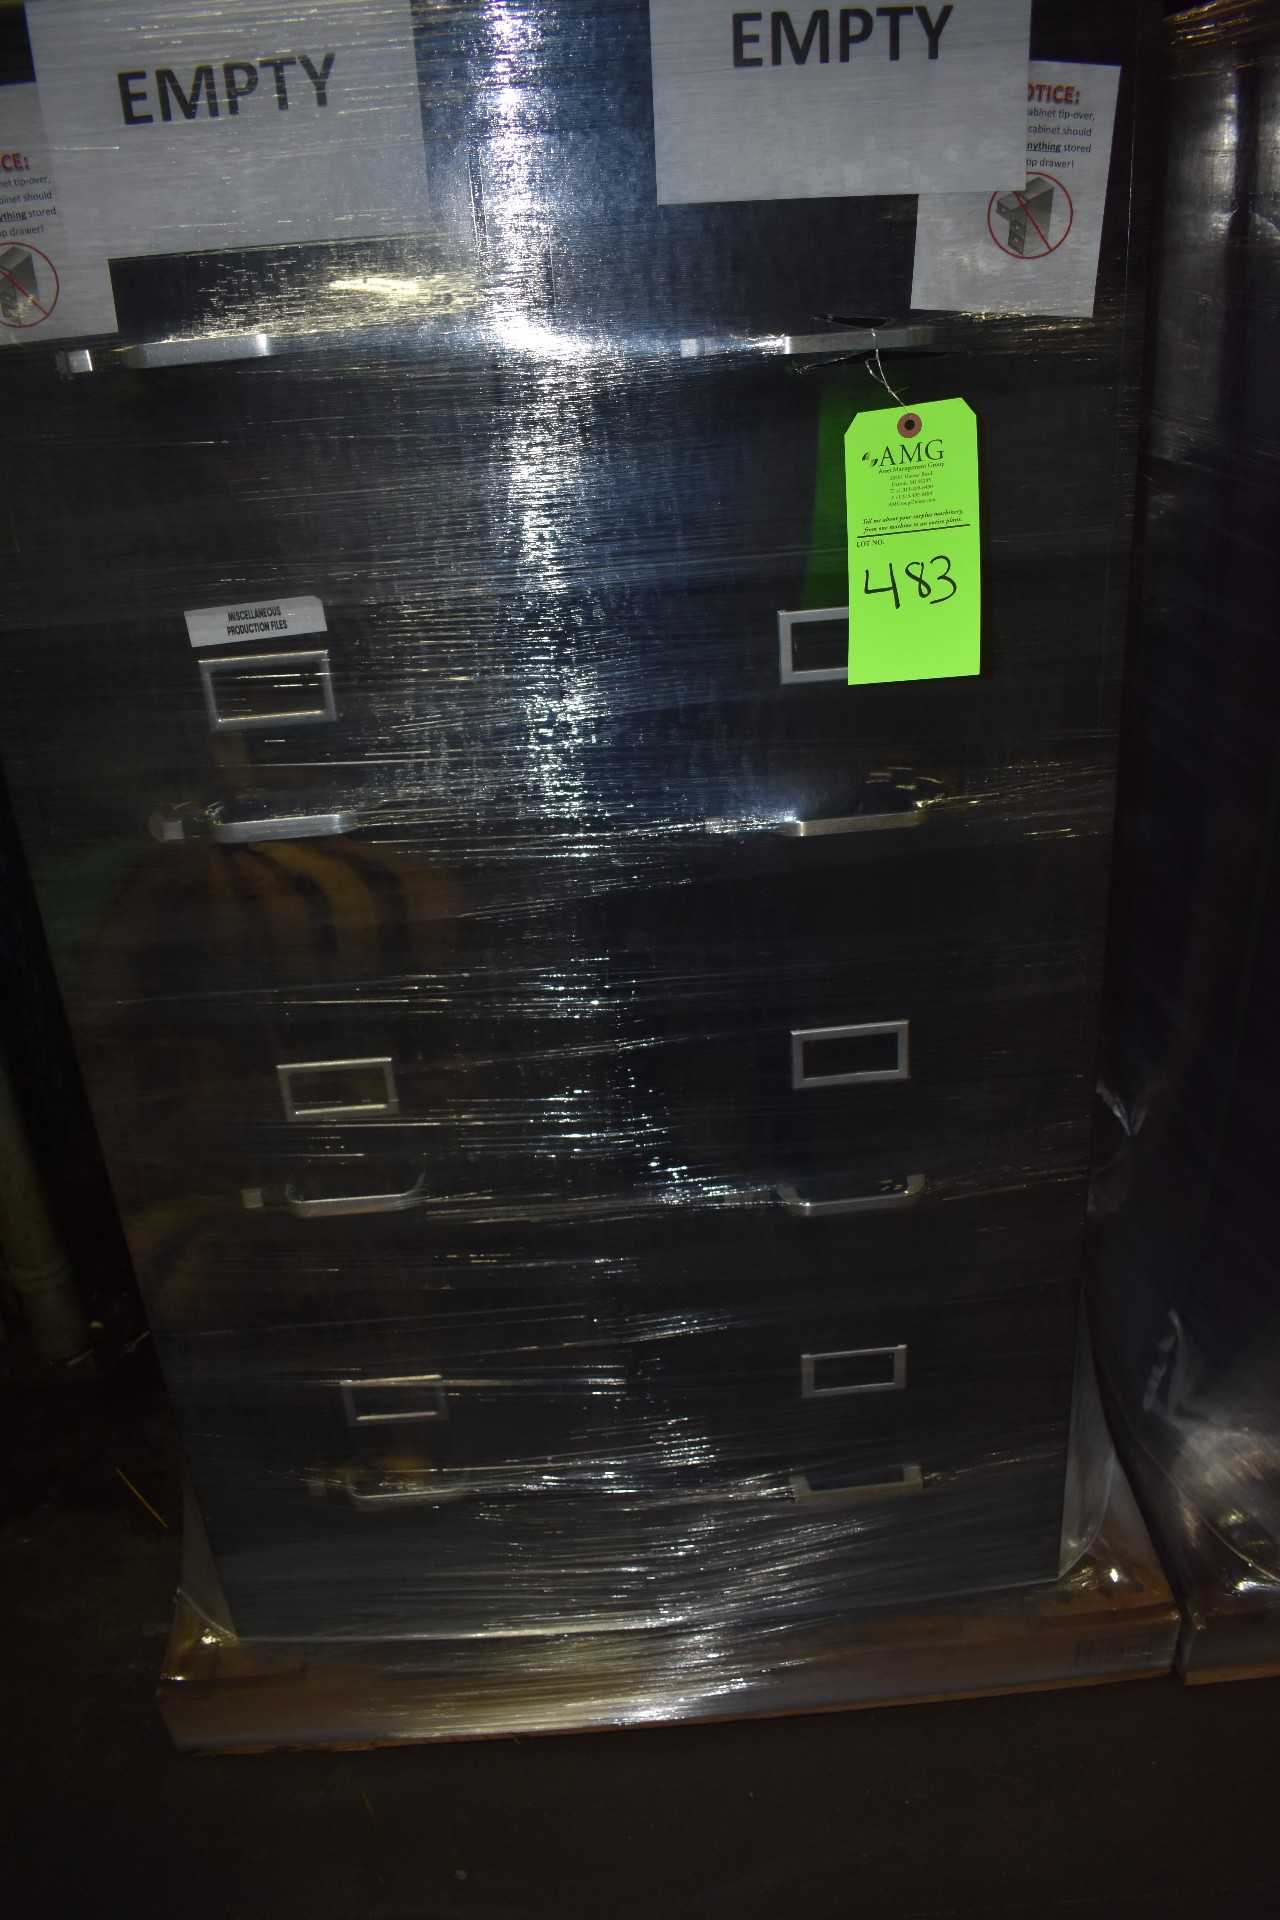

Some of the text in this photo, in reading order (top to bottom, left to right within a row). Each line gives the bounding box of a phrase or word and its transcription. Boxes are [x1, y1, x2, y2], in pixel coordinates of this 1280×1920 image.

[732, 4, 953, 68] EMPTY
[117, 52, 335, 125] EMPTY
[1027, 83, 1080, 104] OTICE:
[1027, 107, 1056, 118] abinet
[1062, 127, 1092, 137] should
[1026, 141, 1092, 153] nything stored
[1026, 158, 1074, 168] op drawer!
[23, 190, 52, 202] should
[29, 205, 57, 218] stored
[879, 439, 944, 467] AMG
[856, 540, 870, 548] LOT
[863, 555, 957, 610] 483
[227, 605, 282, 622] MISCELLANEOUS
[226, 618, 288, 636] PRODUCTION FILES
